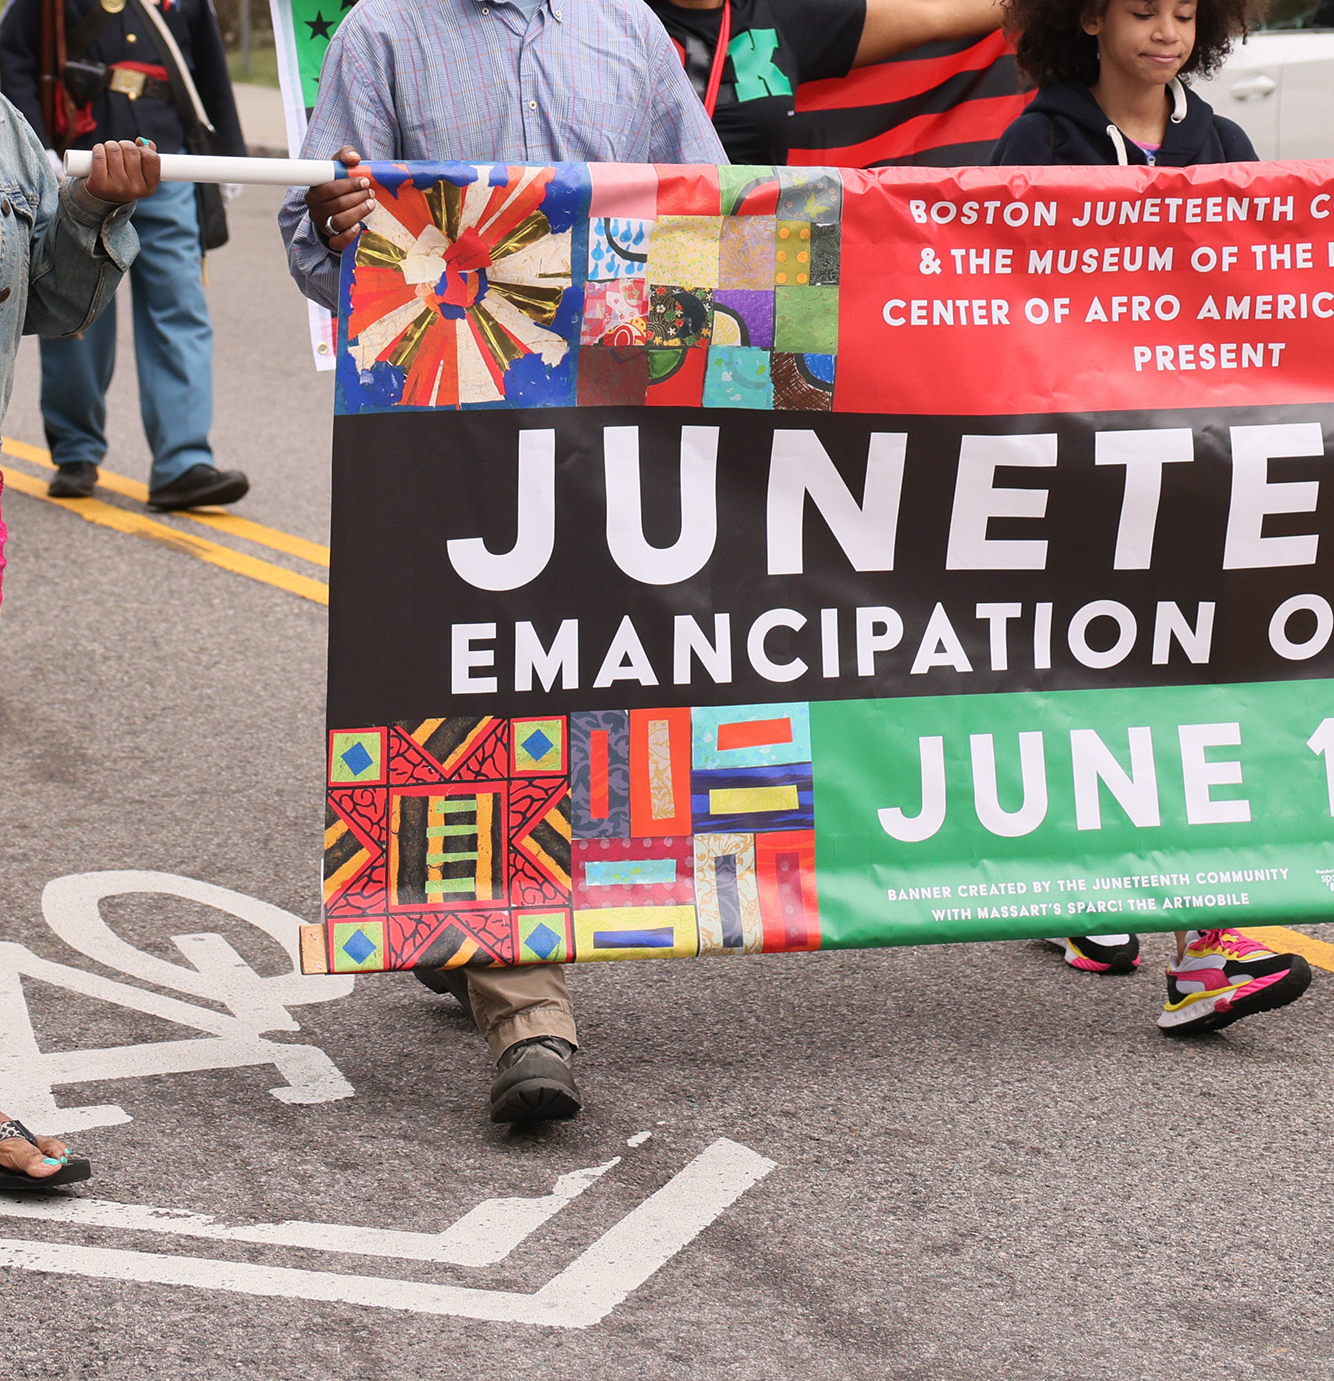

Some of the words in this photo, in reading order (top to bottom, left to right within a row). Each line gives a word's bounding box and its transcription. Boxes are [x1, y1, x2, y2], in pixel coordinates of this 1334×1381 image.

[910, 201, 1056, 226] BOSTON
[1073, 196, 1293, 226] JUNETEENTH
[920, 248, 941, 274] &
[951, 249, 1012, 274] THE
[1029, 247, 1173, 274] MUSEUM
[1191, 247, 1237, 272] OF
[1252, 243, 1312, 270] THE
[883, 300, 1010, 326] CENTER
[1025, 298, 1069, 324] OF
[1085, 295, 1180, 322] AFRO
[1134, 343, 1285, 371] PRESENT
[452, 600, 1215, 694] EMANCIPATION
[878, 722, 1251, 842] JUNE
[888, 886, 952, 900] BANNER
[958, 883, 1027, 897] CREATED
[1033, 881, 1051, 893] BY
[1057, 879, 1086, 891] THE
[1093, 874, 1190, 890] JUNETEENTH
[1196, 868, 1288, 884] COMMUNITY
[932, 908, 971, 920] WITH
[977, 903, 1061, 918] MASSART'S
[1068, 900, 1122, 914] SPARC!
[1127, 899, 1156, 910] THE
[1163, 893, 1249, 909] ARTMOBILE
